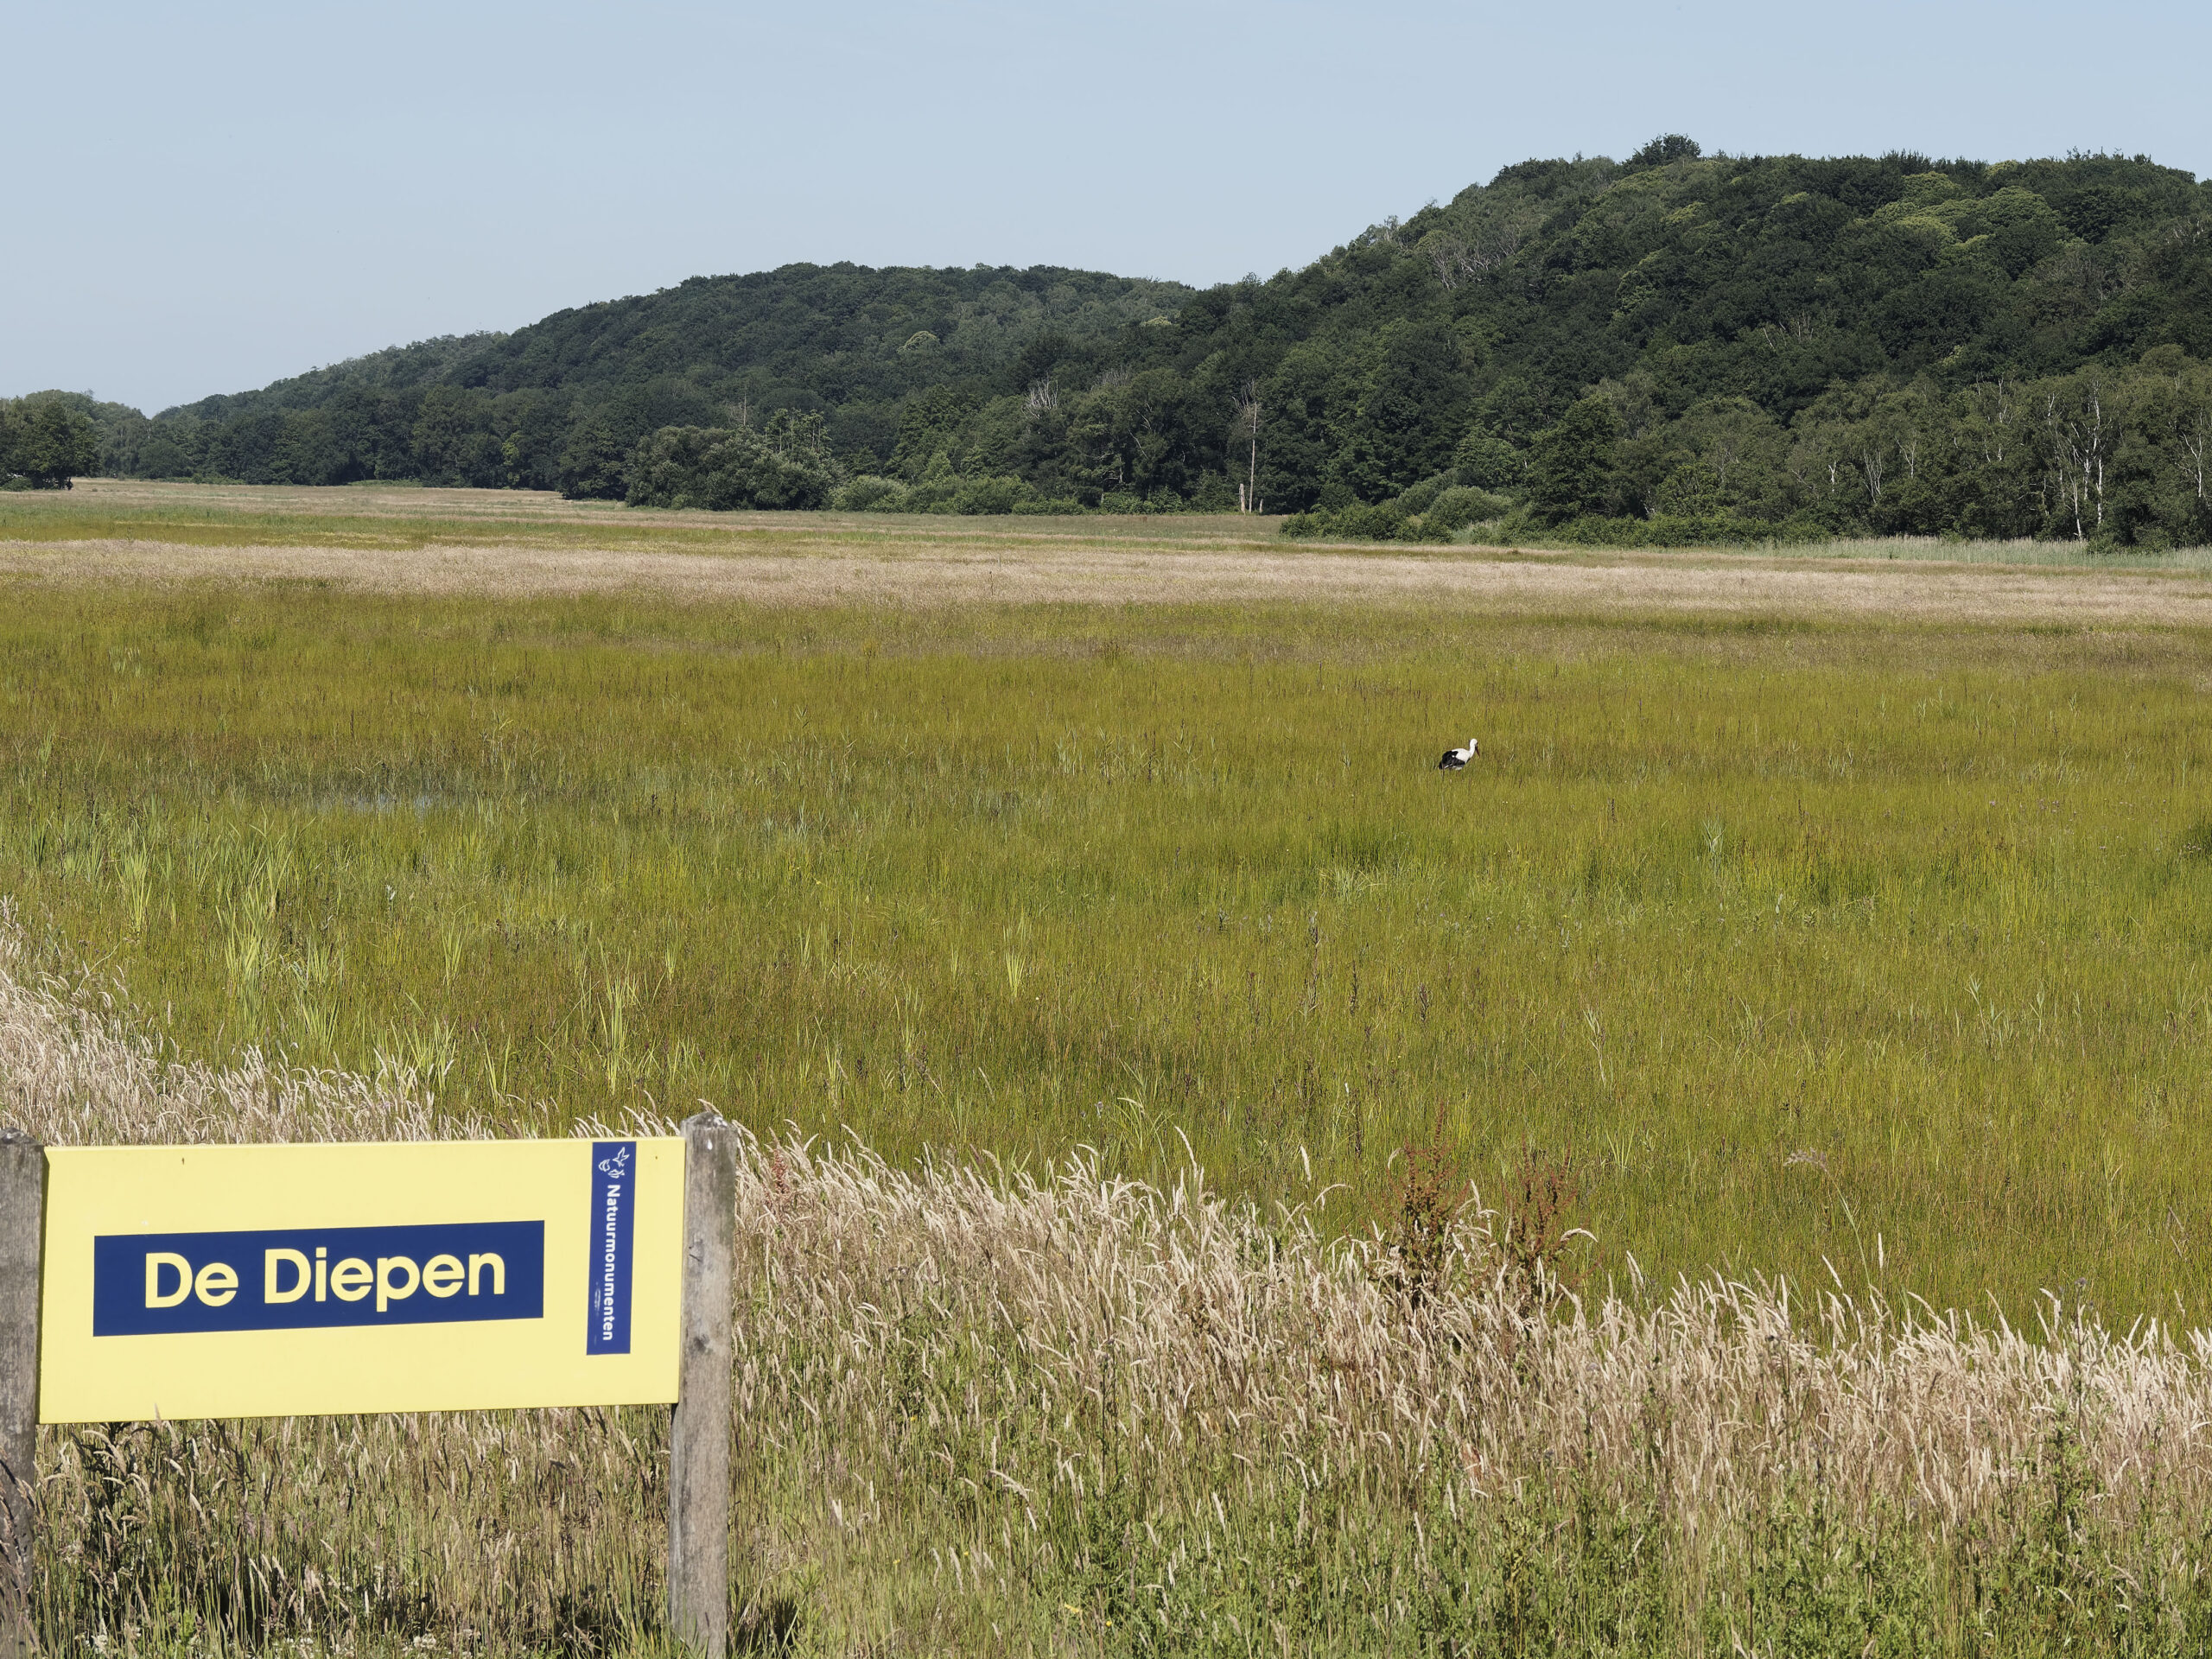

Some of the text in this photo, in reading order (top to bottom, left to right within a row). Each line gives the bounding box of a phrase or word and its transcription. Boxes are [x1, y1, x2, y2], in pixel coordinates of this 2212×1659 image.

[145, 1247, 505, 1313] De Diepen
[601, 1184, 621, 1341] Natuurmonumenten
